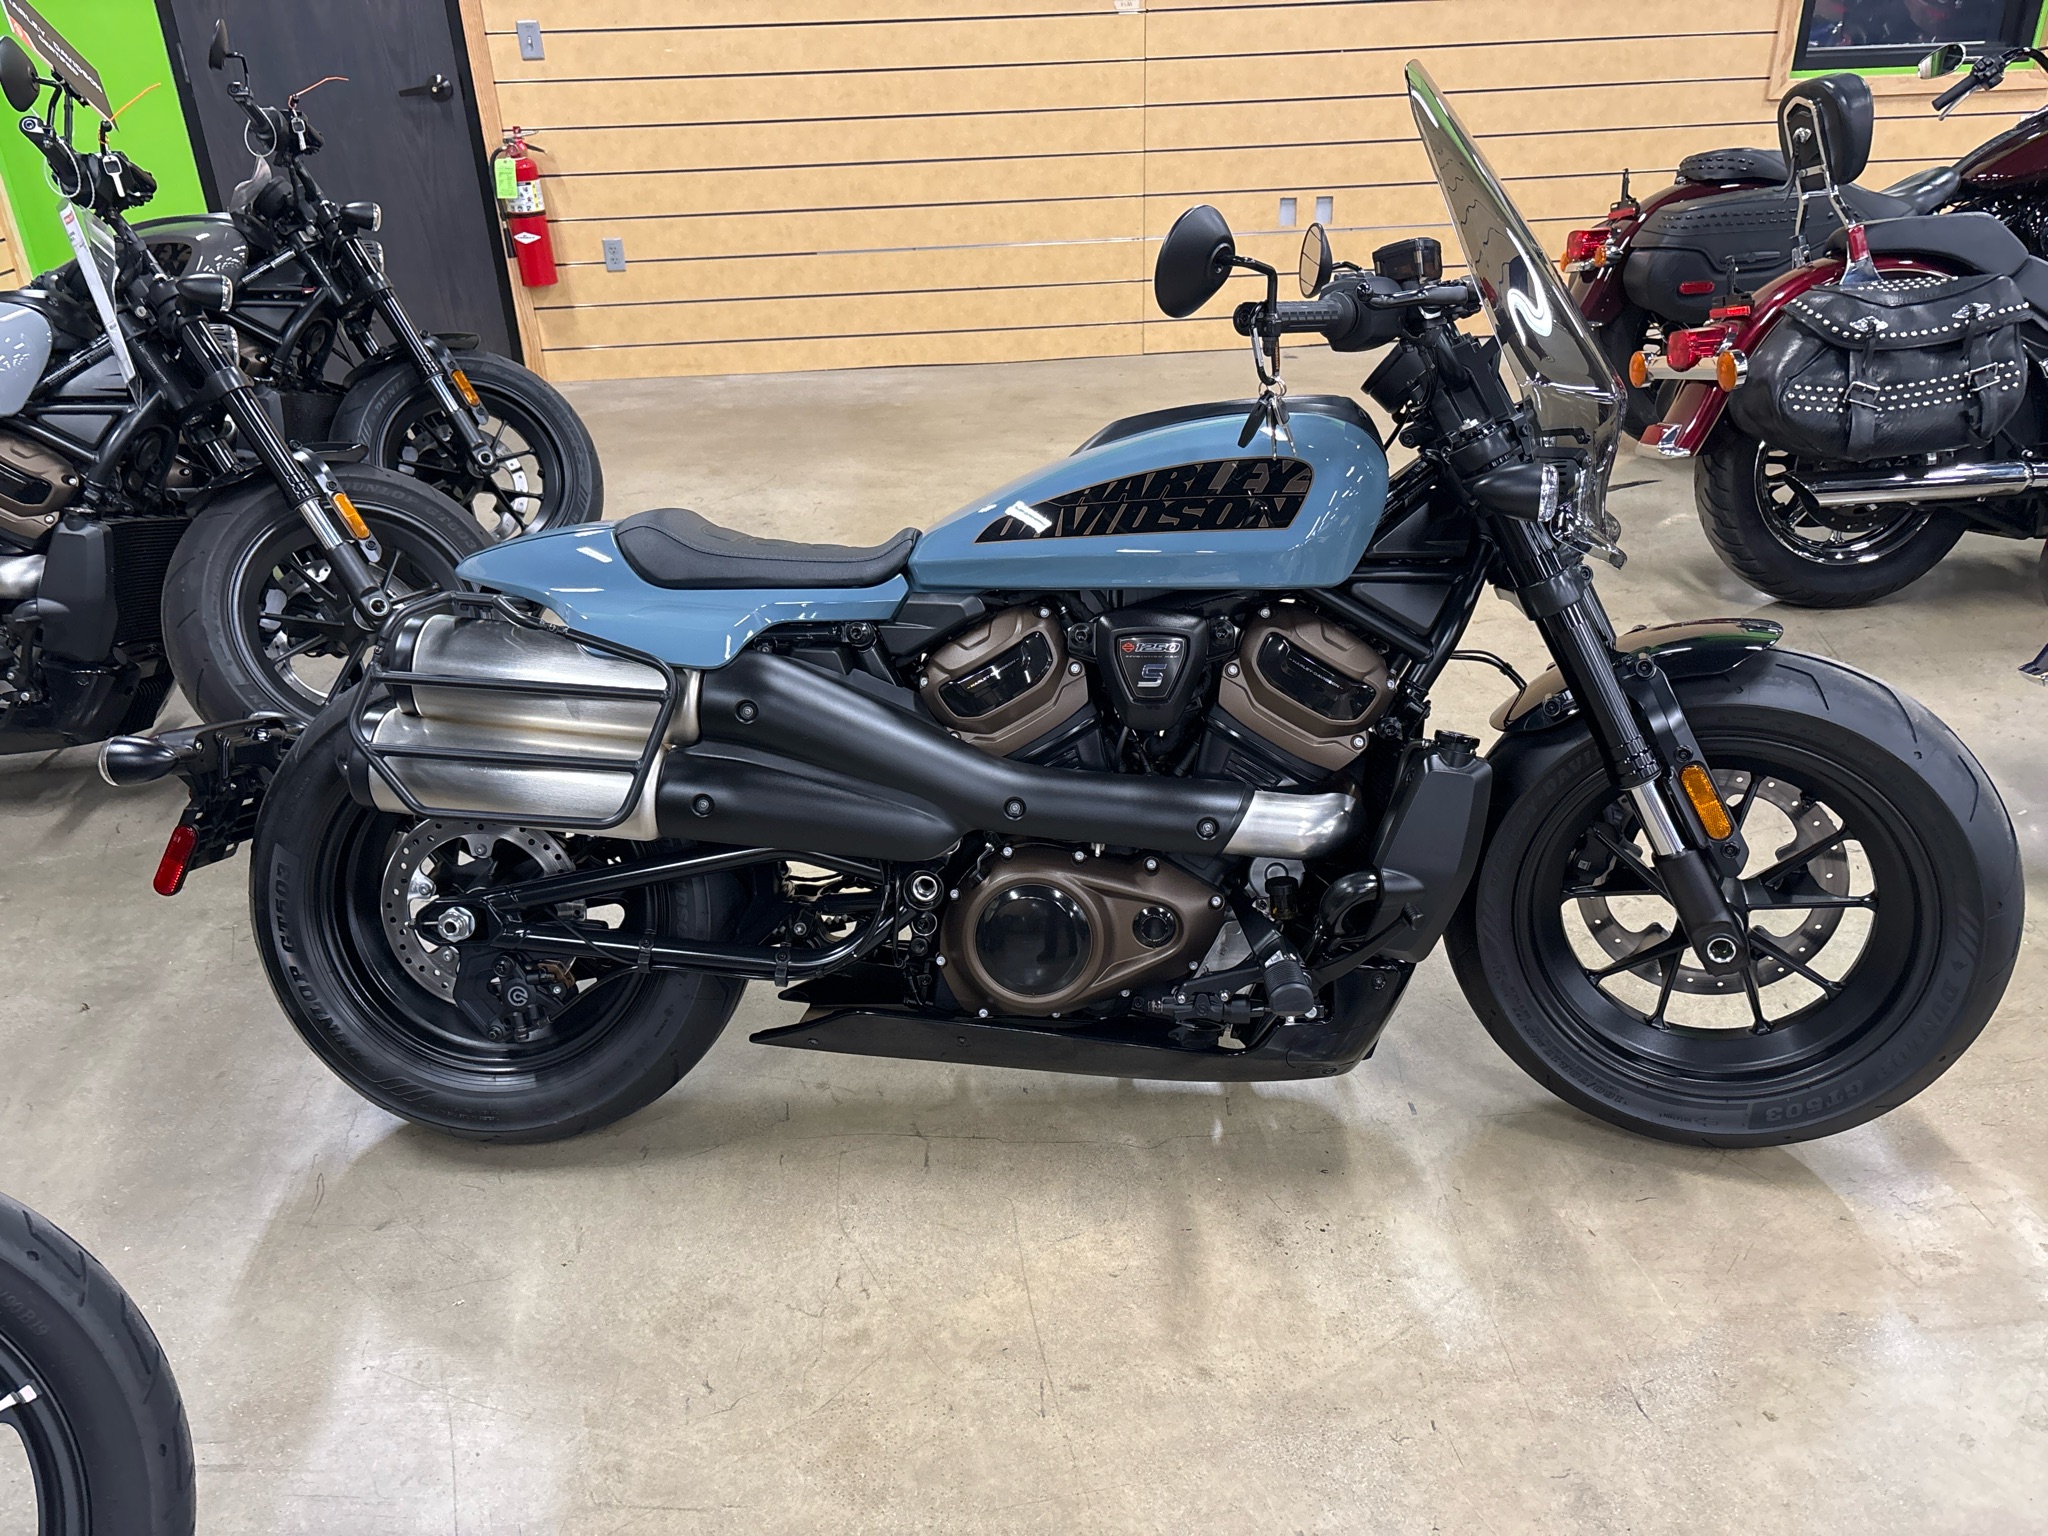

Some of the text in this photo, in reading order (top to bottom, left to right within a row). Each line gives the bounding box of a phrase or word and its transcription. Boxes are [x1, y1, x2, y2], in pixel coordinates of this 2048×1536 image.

[1135, 642, 1181, 653] 1250
[1137, 663, 1168, 688] S
[1764, 1079, 1865, 1123] GT503
